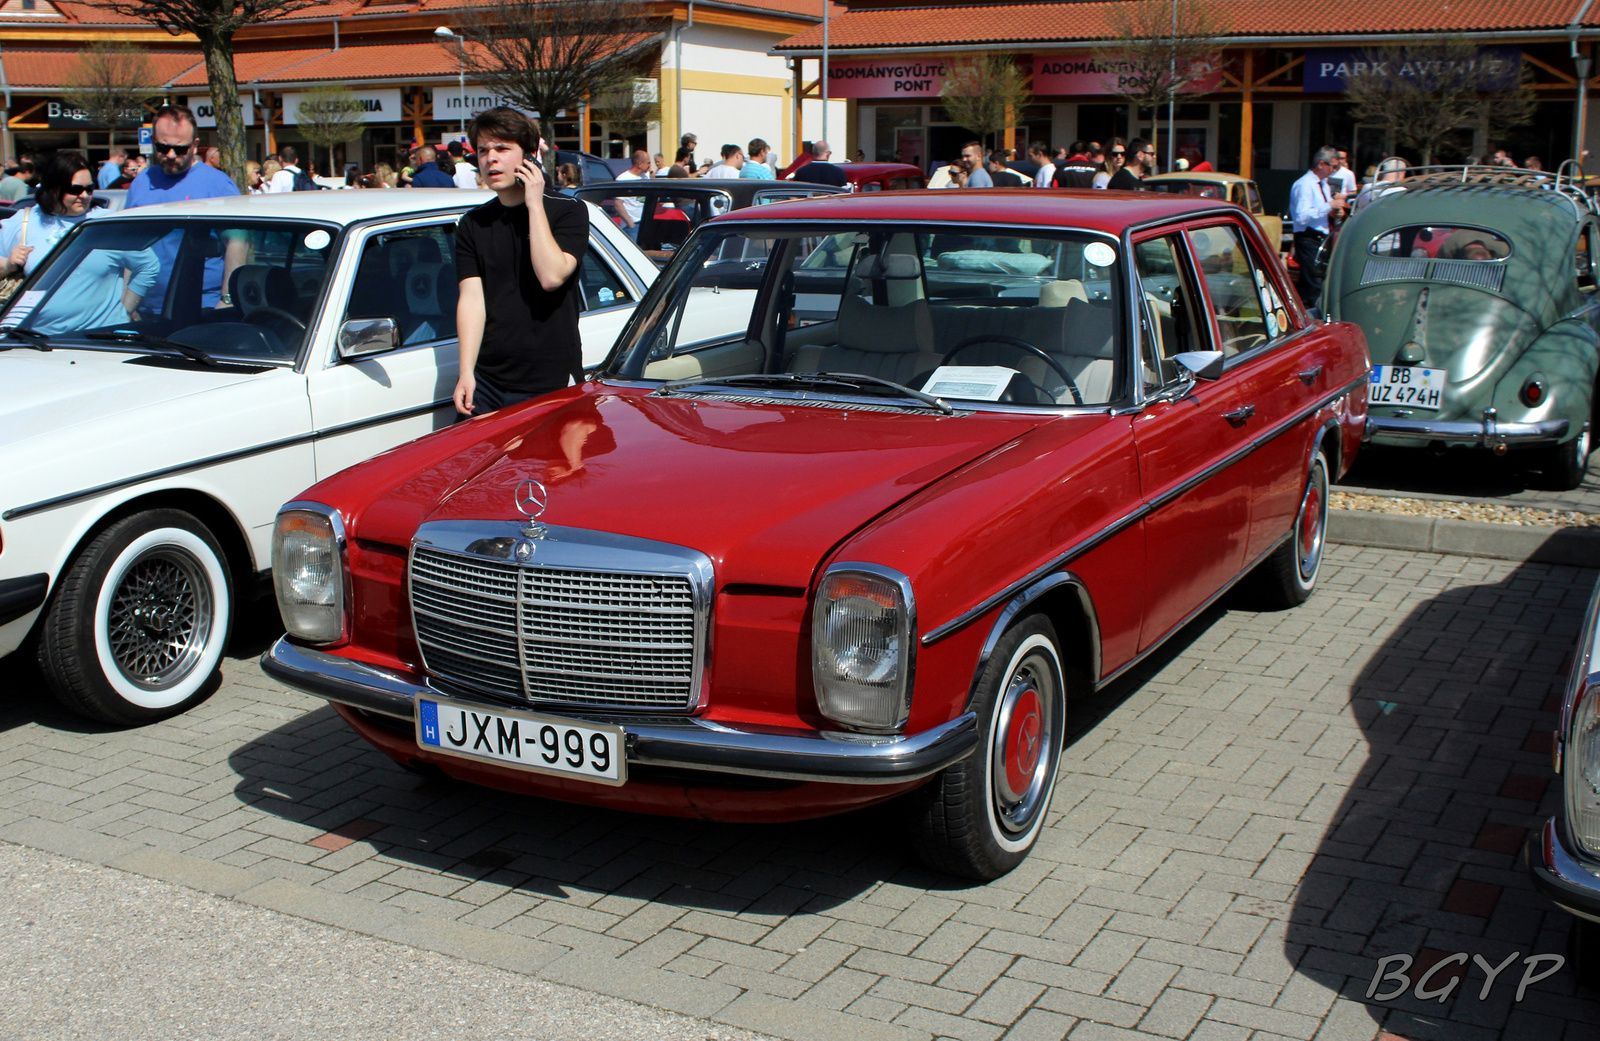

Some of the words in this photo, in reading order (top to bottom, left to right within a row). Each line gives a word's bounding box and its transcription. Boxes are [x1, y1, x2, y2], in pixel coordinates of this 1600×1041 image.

[1320, 62, 1388, 77] PARK
[894, 80, 932, 92] PONT
[140, 130, 149, 143] P
[1391, 367, 1411, 384] BB
[1372, 385, 1391, 402] UZ
[1396, 387, 1439, 406] 474H
[425, 727, 435, 740] H
[446, 710, 610, 772] JXM-999
